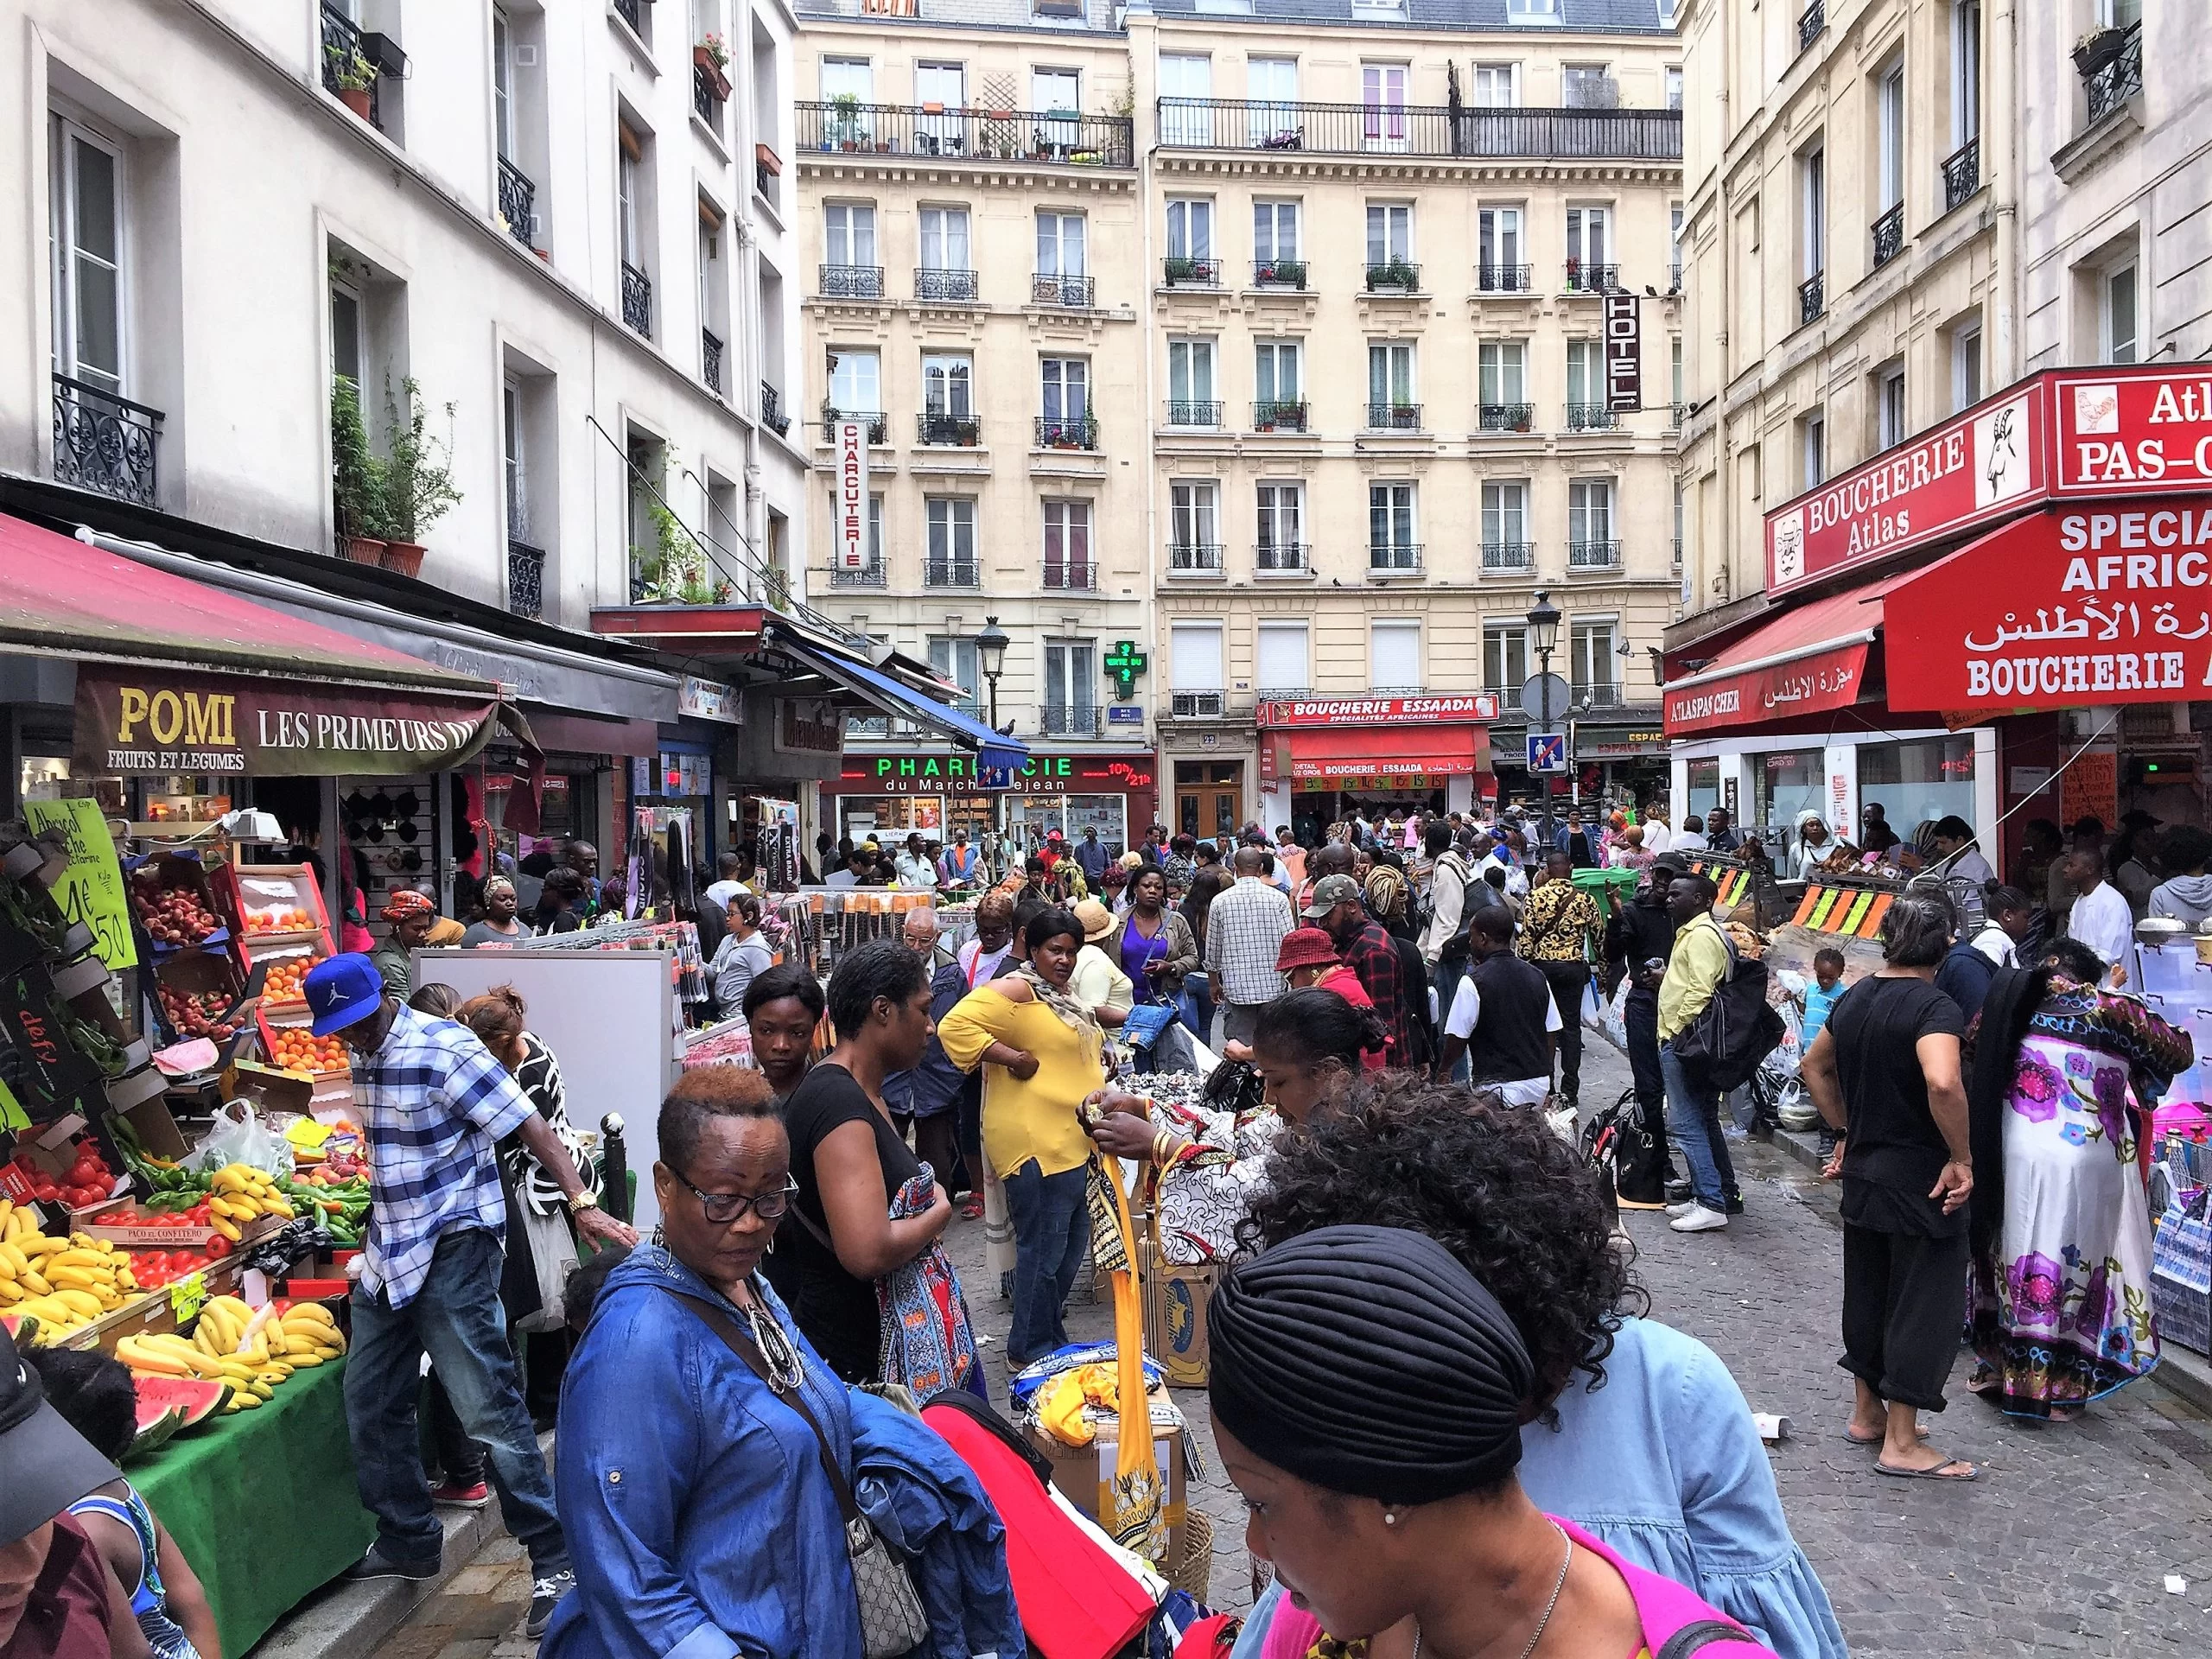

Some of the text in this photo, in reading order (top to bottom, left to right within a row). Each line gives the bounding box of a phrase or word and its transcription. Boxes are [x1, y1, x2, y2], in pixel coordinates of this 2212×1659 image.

[1609, 297, 1637, 397] HOTEL
[844, 425, 860, 567] CHARCUTERIE
[1808, 429, 1966, 535] BOUCHERIE
[1846, 507, 1910, 557] Atlas
[2060, 551, 2212, 593] AFRIC
[1966, 651, 2184, 697] BOUCHERIE
[118, 687, 236, 746] POMI
[1294, 697, 1473, 716] BOUCHERIE ESSAADA
[1713, 690, 1740, 715] CHER
[257, 709, 309, 749] LES
[315, 714, 448, 752] PRIMEURS
[1629, 733, 1664, 741] ESPAC
[107, 749, 156, 769] FRUITS
[159, 752, 178, 769] ET
[877, 758, 1072, 777] PHARCIE
[1325, 763, 1423, 775] BOUCHERIE ESSAADA
[886, 779, 1065, 792] du March ejean
